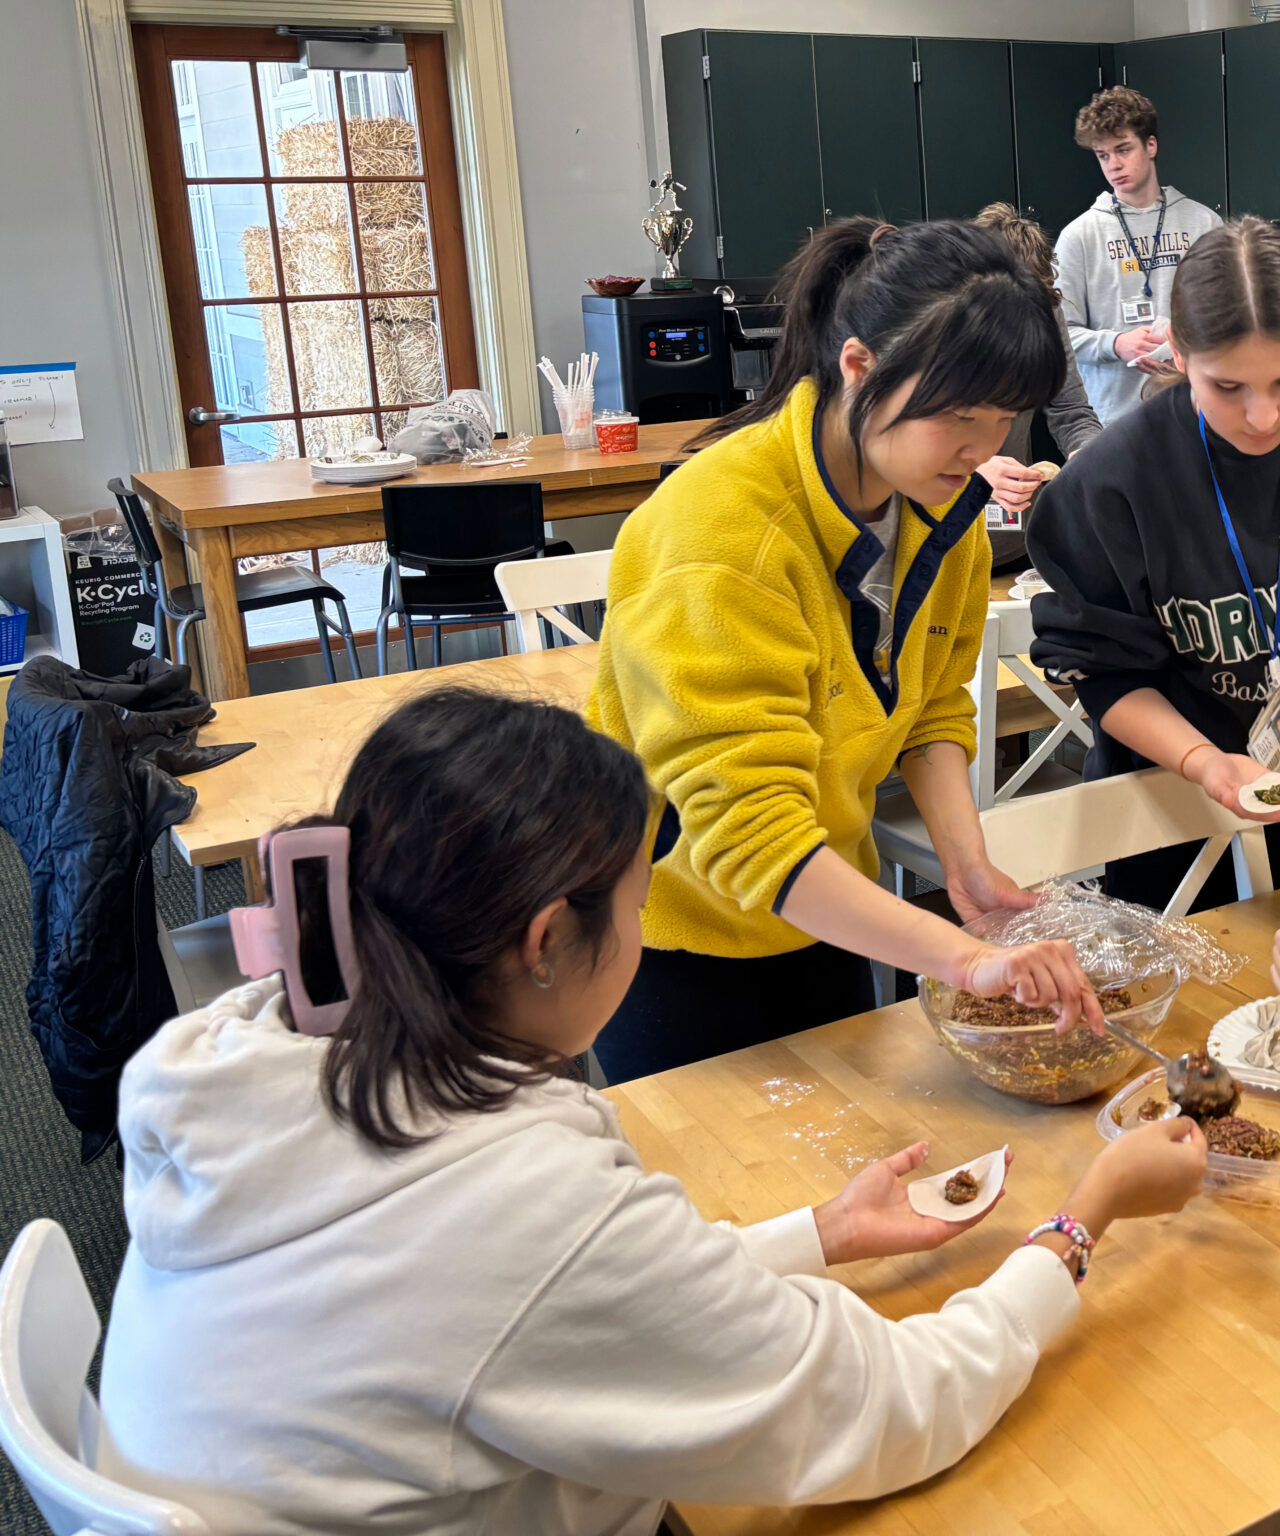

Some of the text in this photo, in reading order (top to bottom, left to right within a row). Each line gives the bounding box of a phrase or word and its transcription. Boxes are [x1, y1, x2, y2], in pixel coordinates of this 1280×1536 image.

[1107, 235, 1150, 260] SEVEN
[75, 576, 102, 585] KEURIG
[79, 604, 140, 616] Recycling Program
